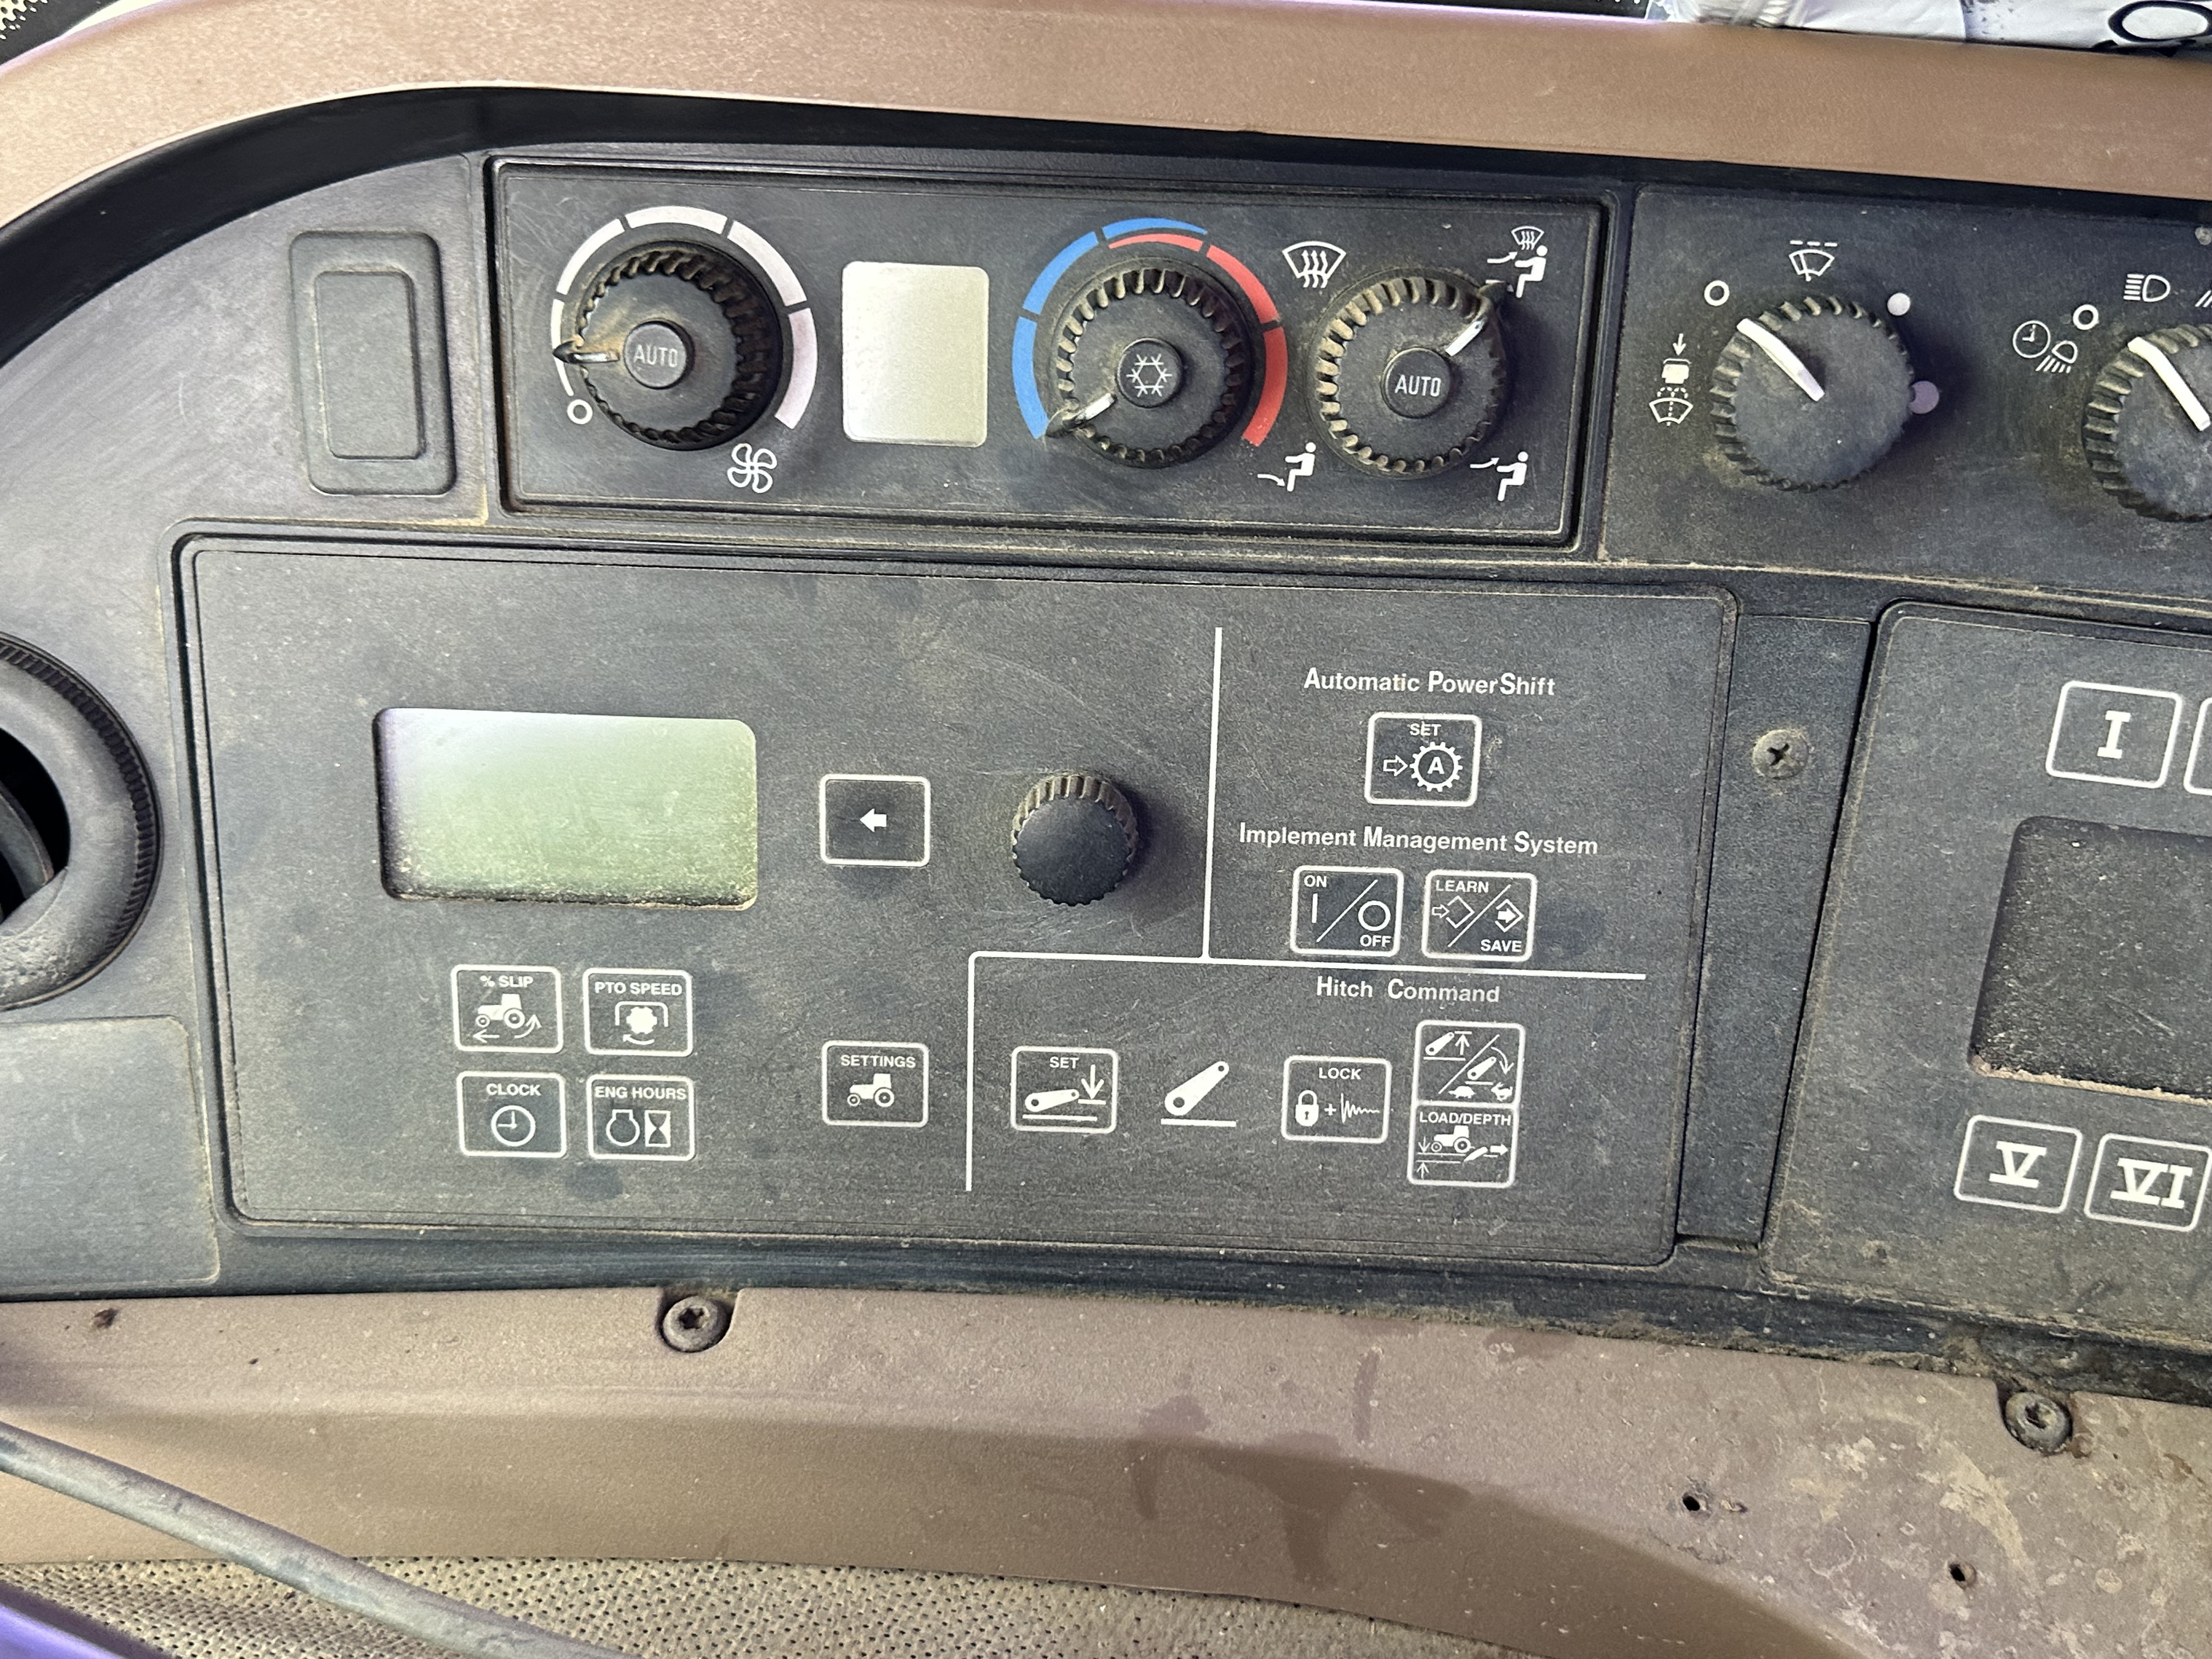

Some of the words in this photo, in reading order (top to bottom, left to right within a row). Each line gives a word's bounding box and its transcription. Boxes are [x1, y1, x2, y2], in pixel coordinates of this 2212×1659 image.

[633, 343, 679, 368] AUTO
[1394, 374, 1442, 397] AUTO
[1303, 667, 1420, 692] Automatic
[1409, 723, 1442, 737] SET
[1427, 757, 1446, 775] A
[1239, 822, 1356, 847] Implement
[1363, 826, 1507, 854] Management
[1513, 831, 1598, 857] System
[1304, 874, 1328, 888] ON
[1435, 879, 1489, 893] LEARN
[1359, 935, 1392, 947] OFF
[1480, 939, 1523, 952] SAVE
[479, 975, 496, 988] %
[498, 975, 534, 988] SLIP
[594, 981, 627, 994] PTO
[629, 982, 683, 996] SPEED
[1316, 975, 1373, 998] Hitch
[1387, 978, 1500, 1003] Command
[840, 1054, 917, 1069] SETTINGS
[1049, 1056, 1080, 1069] SET
[1318, 1067, 1362, 1080] LOCK
[486, 1083, 541, 1097] CLOCK
[594, 1086, 628, 1099] ENG
[631, 1087, 687, 1100] HOURS
[1419, 1111, 1512, 1126] LOAD/DEPTH
